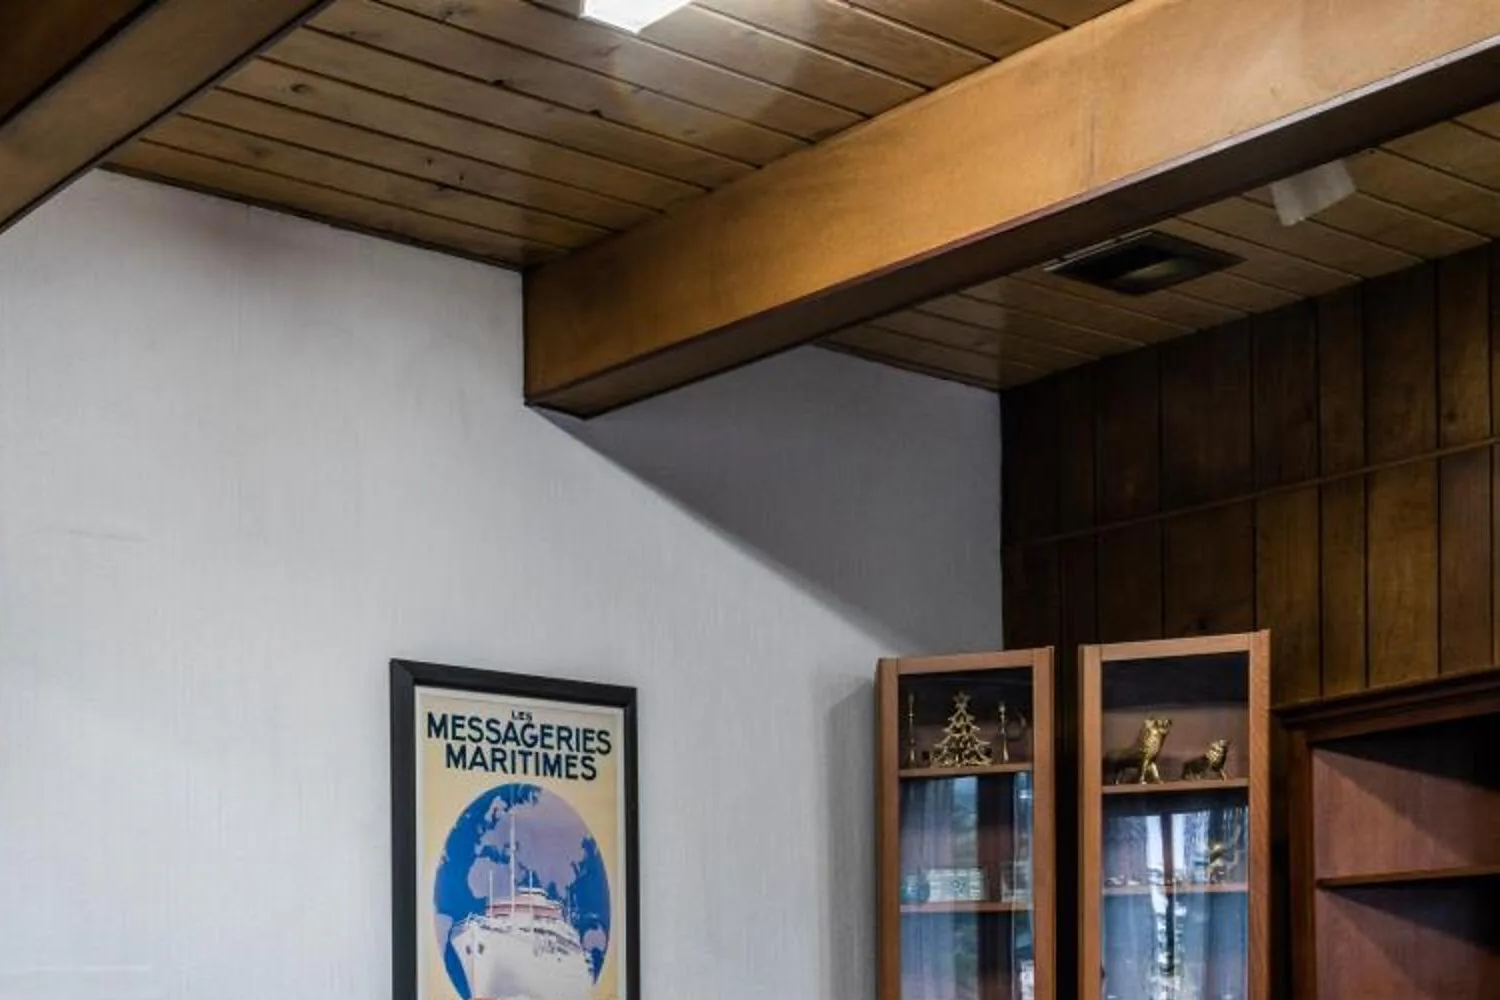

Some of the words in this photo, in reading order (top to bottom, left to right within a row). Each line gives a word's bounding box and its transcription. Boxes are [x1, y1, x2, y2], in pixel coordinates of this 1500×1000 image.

[427, 711, 612, 756] MESSAGERIES
[511, 710, 532, 721] LES
[445, 743, 597, 781] MARITIMES
